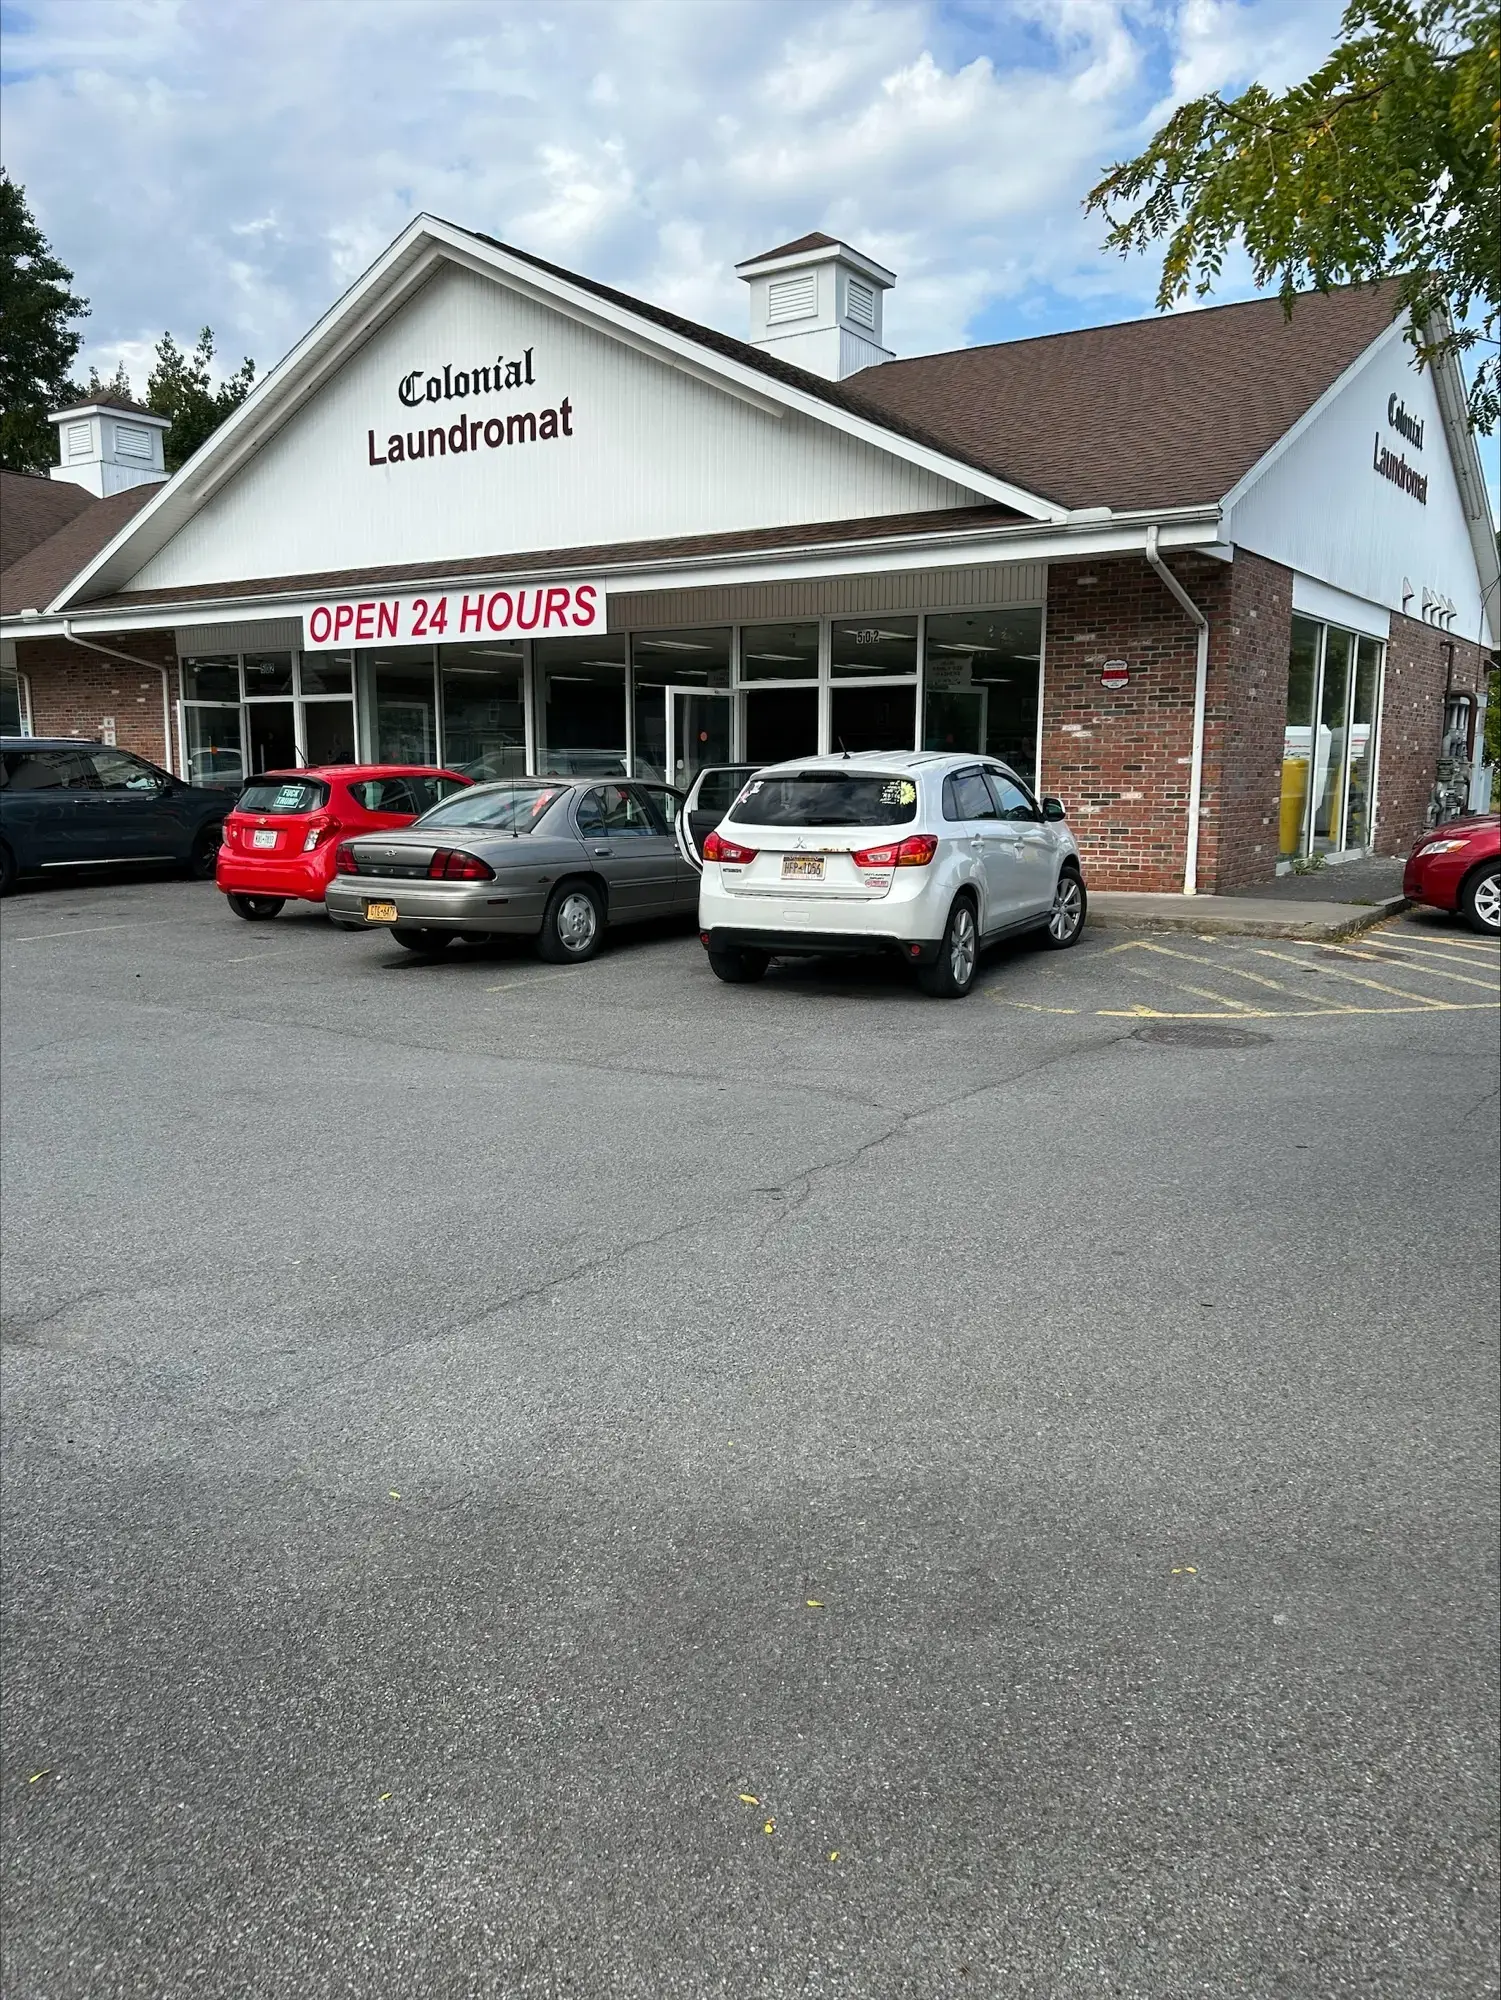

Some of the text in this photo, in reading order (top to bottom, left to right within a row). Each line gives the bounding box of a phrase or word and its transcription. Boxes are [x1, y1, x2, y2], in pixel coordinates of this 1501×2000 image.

[398, 347, 536, 407] Colonial
[368, 396, 573, 466] Laundromat
[1387, 392, 1425, 451] Colonial
[1373, 431, 1428, 505] Laundromat
[310, 585, 597, 643] OPEN 24 HOURS
[857, 630, 879, 643] 502
[276, 796, 300, 806] TRUMP
[282, 788, 301, 798] FUCK
